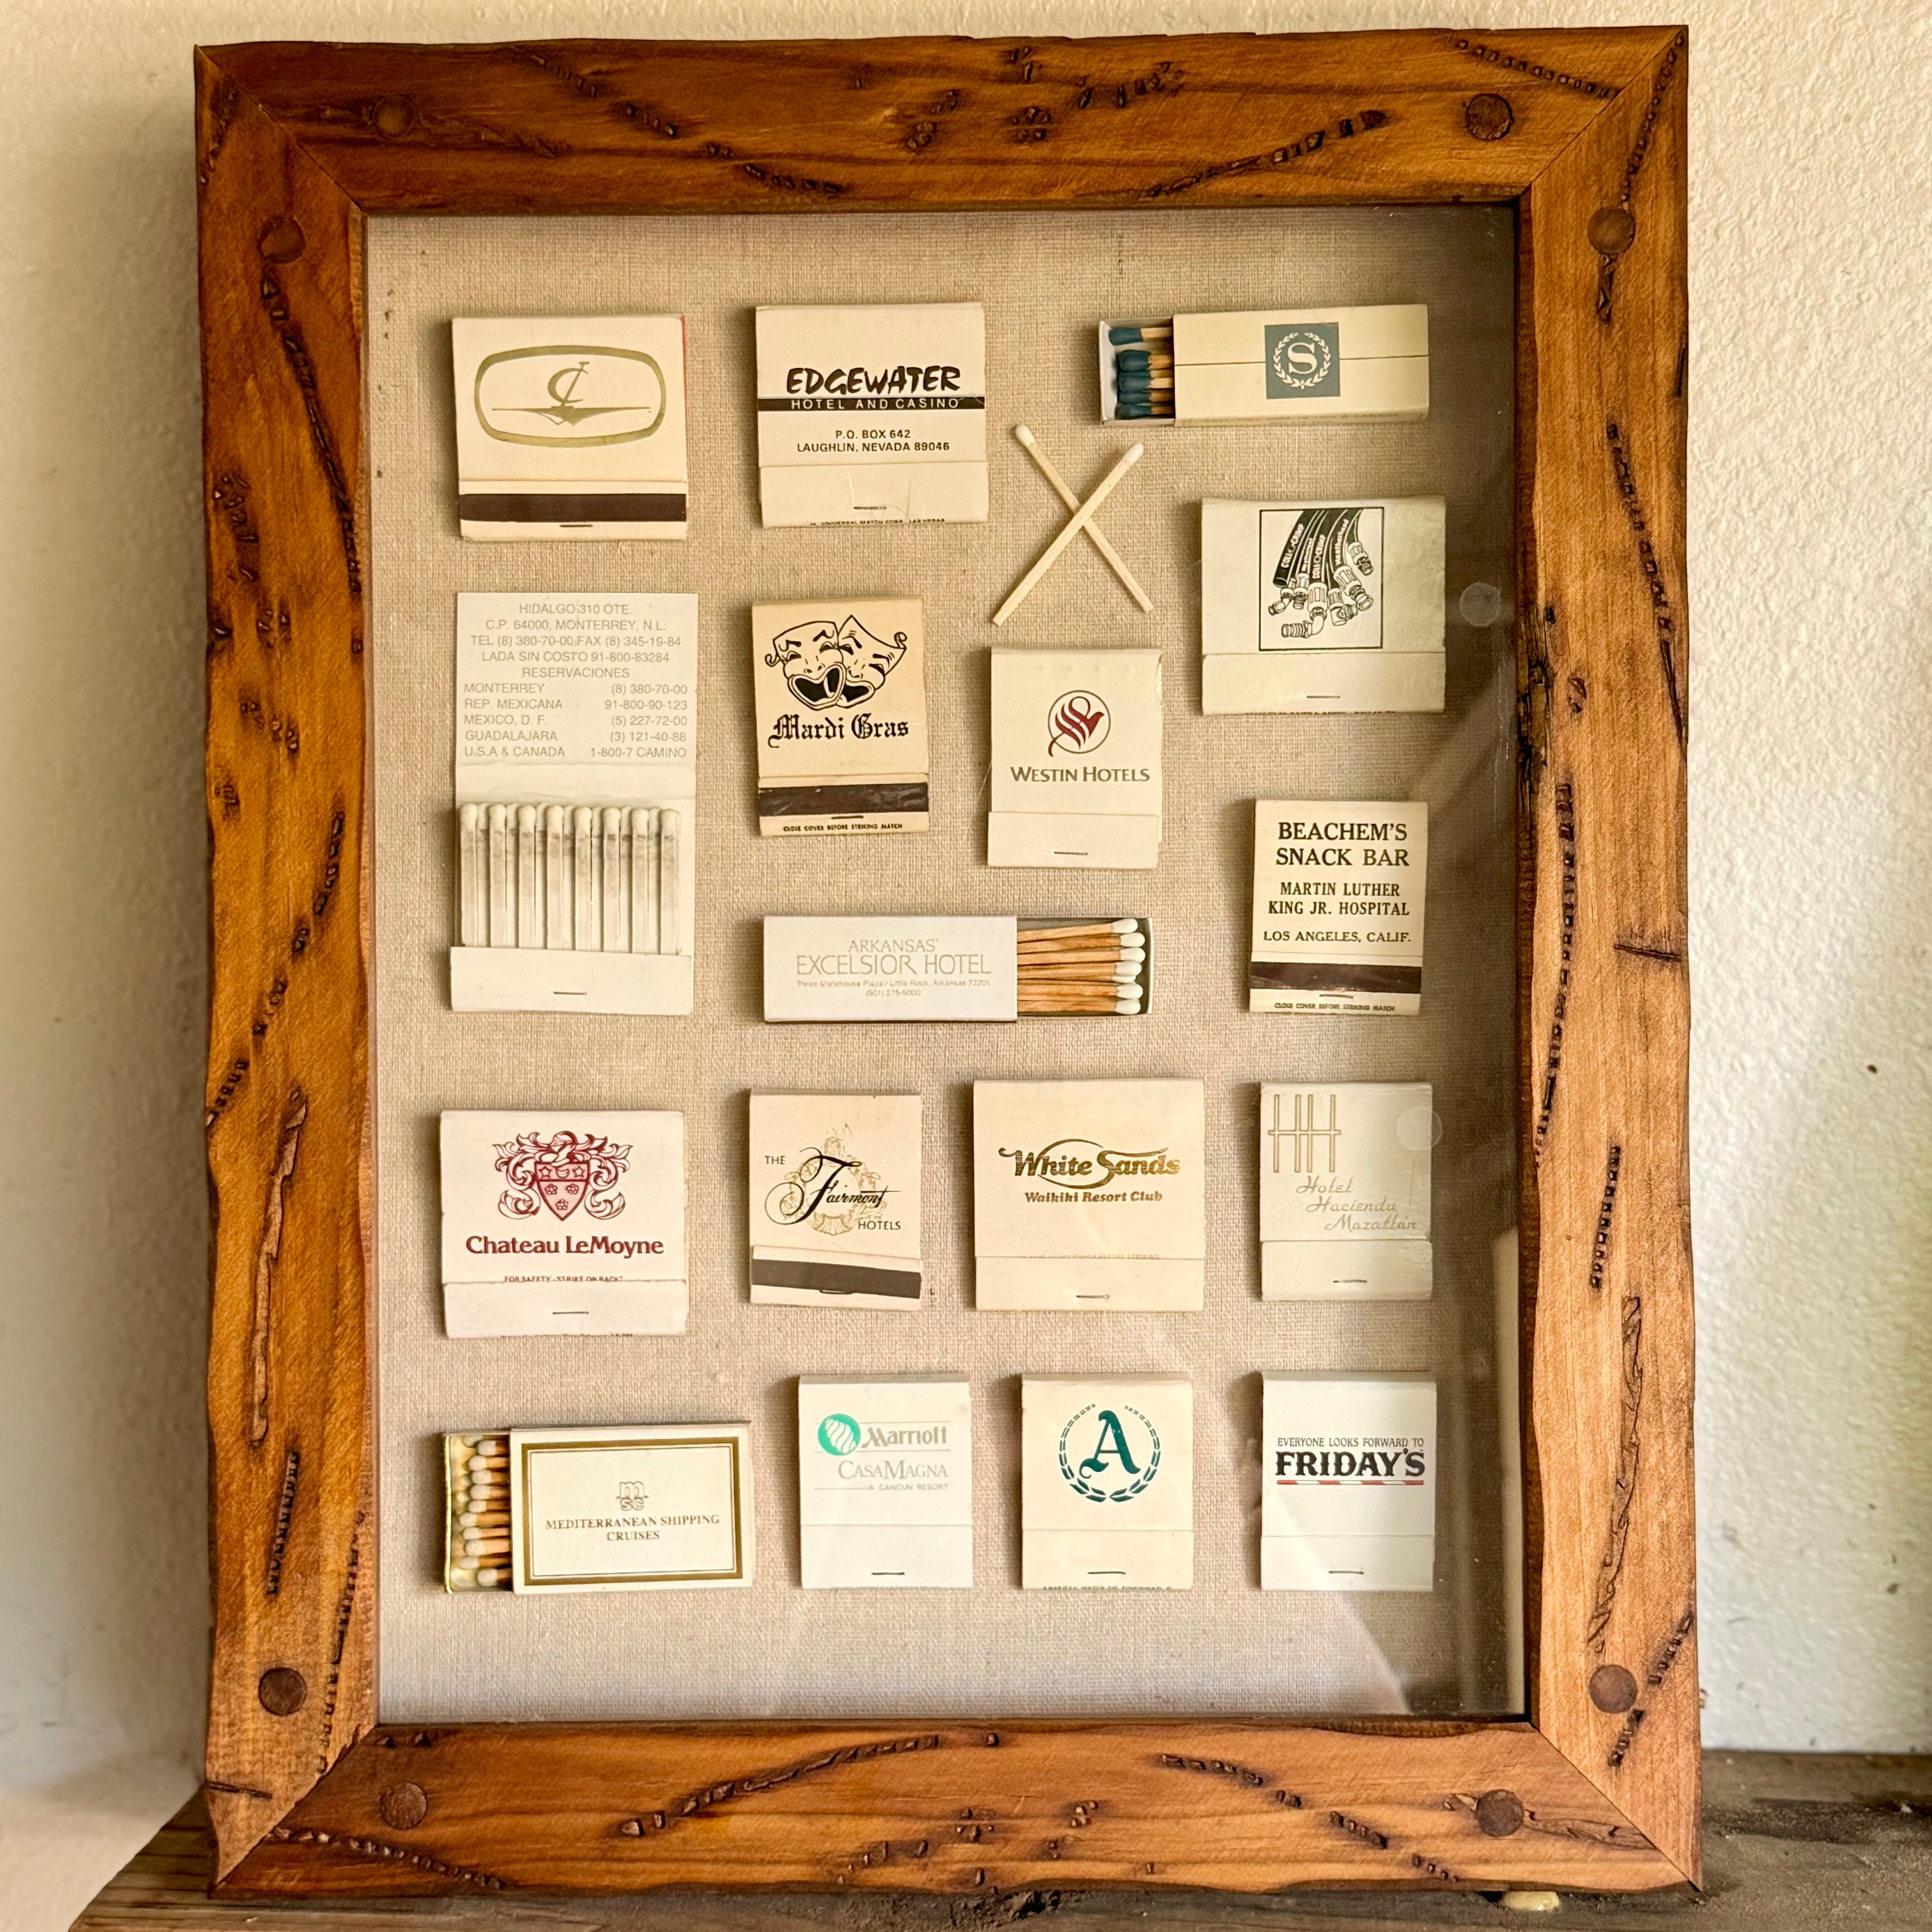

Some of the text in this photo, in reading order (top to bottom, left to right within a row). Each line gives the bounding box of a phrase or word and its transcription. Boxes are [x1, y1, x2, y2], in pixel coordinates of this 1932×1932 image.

[1287, 342, 1318, 374] S
[787, 366, 960, 395] EDGEWATER
[791, 398, 959, 410] HOTEL AND CASINO
[836, 430, 911, 439] P.O. BOX 642
[797, 442, 950, 452] LAUGHLIN, NEVADA 89046
[519, 604, 632, 614] HIDALGO 310 OTE.
[486, 620, 510, 629] C.P.
[514, 620, 551, 631] 64000,
[556, 620, 639, 631] MONTERREY,
[471, 635, 681, 648] TEL (8) 380-70-00 FAX (8) 345-19-84
[482, 652, 669, 662] LADA SIN COSTO 91-800-83284
[523, 667, 630, 678] RESERVACIONES
[464, 683, 688, 696] MONTERREY (8) 380-70-00
[465, 698, 688, 710] REP. MEXICANA 91-800-90-123
[464, 714, 687, 728] MEXICO, D. F. (5) 227-72-00
[465, 730, 686, 744] GUADALAJARA (3) 121-40-88
[768, 713, 909, 748] Mardi Gras
[501, 747, 509, 757] &
[513, 747, 565, 757] CANADA
[591, 748, 633, 757] 1-800-7
[636, 747, 687, 758] CAMINO
[1010, 766, 1150, 782] WESTIN HOTELS
[1278, 822, 1407, 841] BEACHEM'S
[1276, 848, 1409, 866] SNACK BAR
[1280, 882, 1400, 896] MARTIN LUTHER
[1268, 901, 1409, 915] KING JR. HOSPITAL
[1264, 931, 1411, 942] LOS ANGELES, CALIF.
[848, 938, 939, 952] ARKANSAS'
[796, 954, 991, 975] EXCELSIOR HOTEL
[764, 1155, 786, 1165] THE
[998, 1146, 1180, 1186] White Sands
[765, 1147, 902, 1225] Fairmont
[1296, 1175, 1353, 1194] Hotel
[1025, 1191, 1162, 1202] Waikiki Resort Club
[1305, 1196, 1399, 1214] Hacienda
[858, 1221, 901, 1230] HOTELS
[466, 1236, 664, 1259] Chateau LeMoyne
[860, 1426, 947, 1448] Marriott
[1277, 1437, 1424, 1447] EVERYONE LOOKS FORWARD TO
[1079, 1410, 1141, 1479] A
[1274, 1448, 1425, 1477] FRIDAY'S
[545, 1514, 720, 1530] MEDITERRANEAN SHIPPING
[607, 1530, 660, 1542] CRUISES
